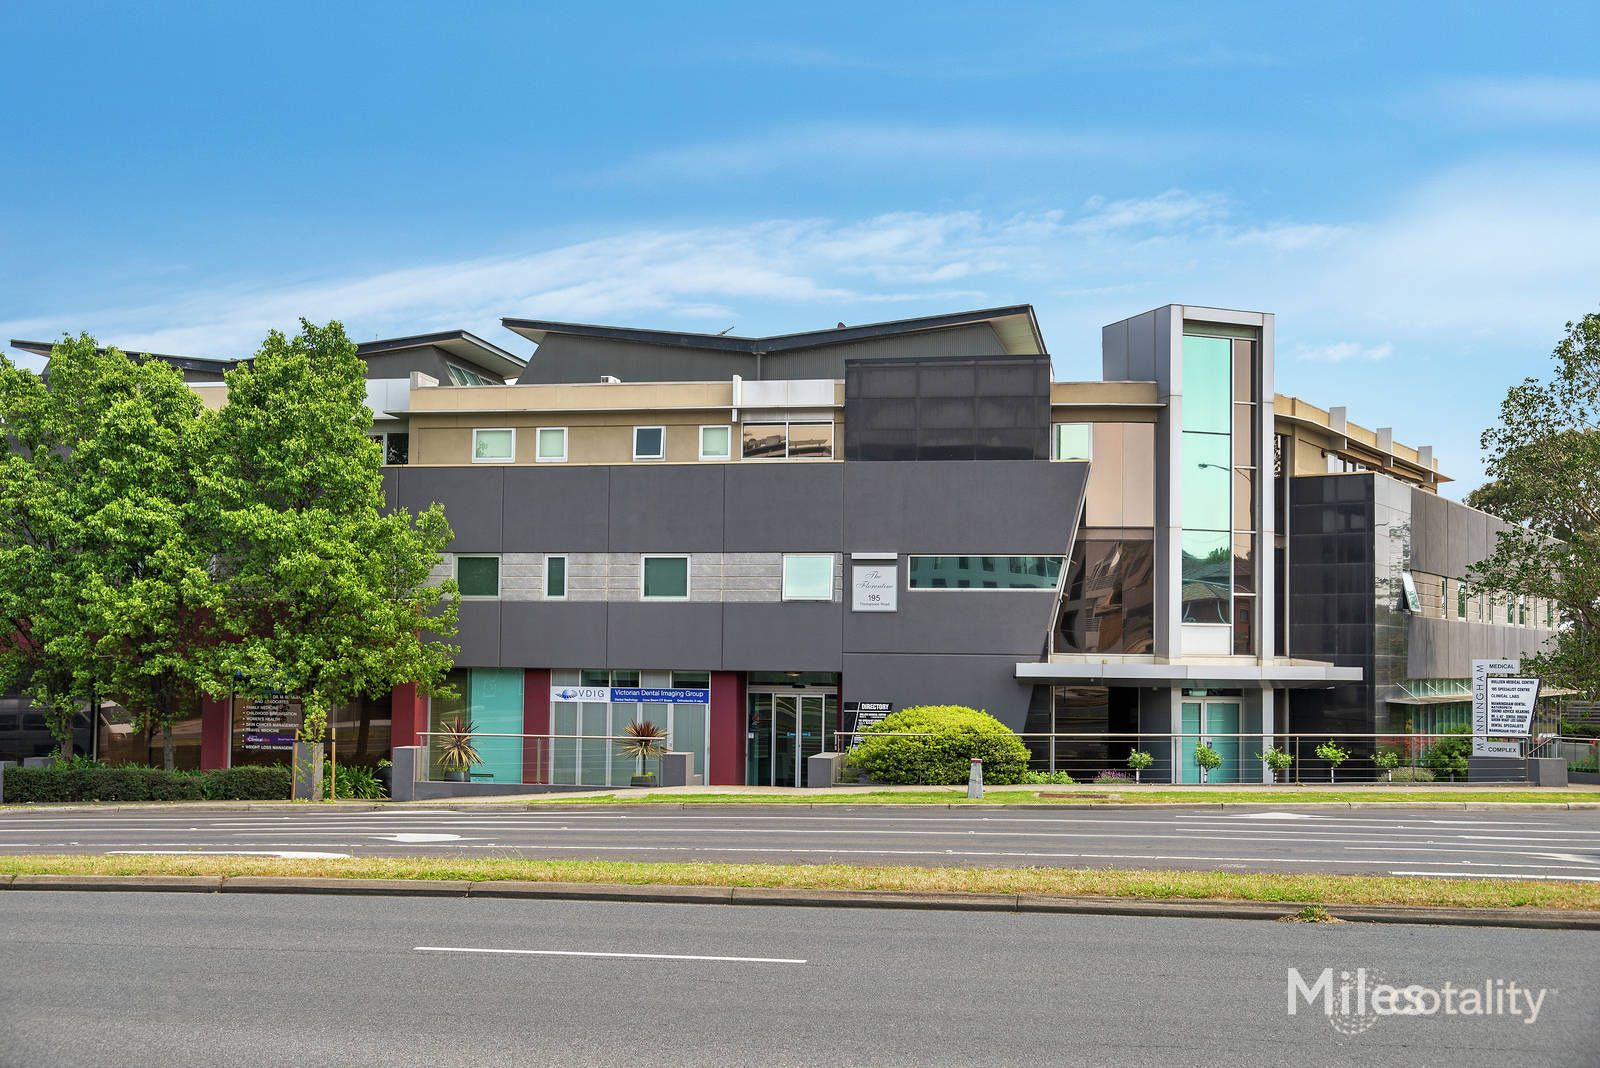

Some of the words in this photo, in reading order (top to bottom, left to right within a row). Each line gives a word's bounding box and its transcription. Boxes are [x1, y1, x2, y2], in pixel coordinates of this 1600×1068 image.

[863, 571, 881, 579] The
[868, 594, 880, 602] 195
[661, 690, 684, 698] Imaging
[685, 690, 704, 698] Group
[1476, 664, 1484, 751] MANNINGHAM
